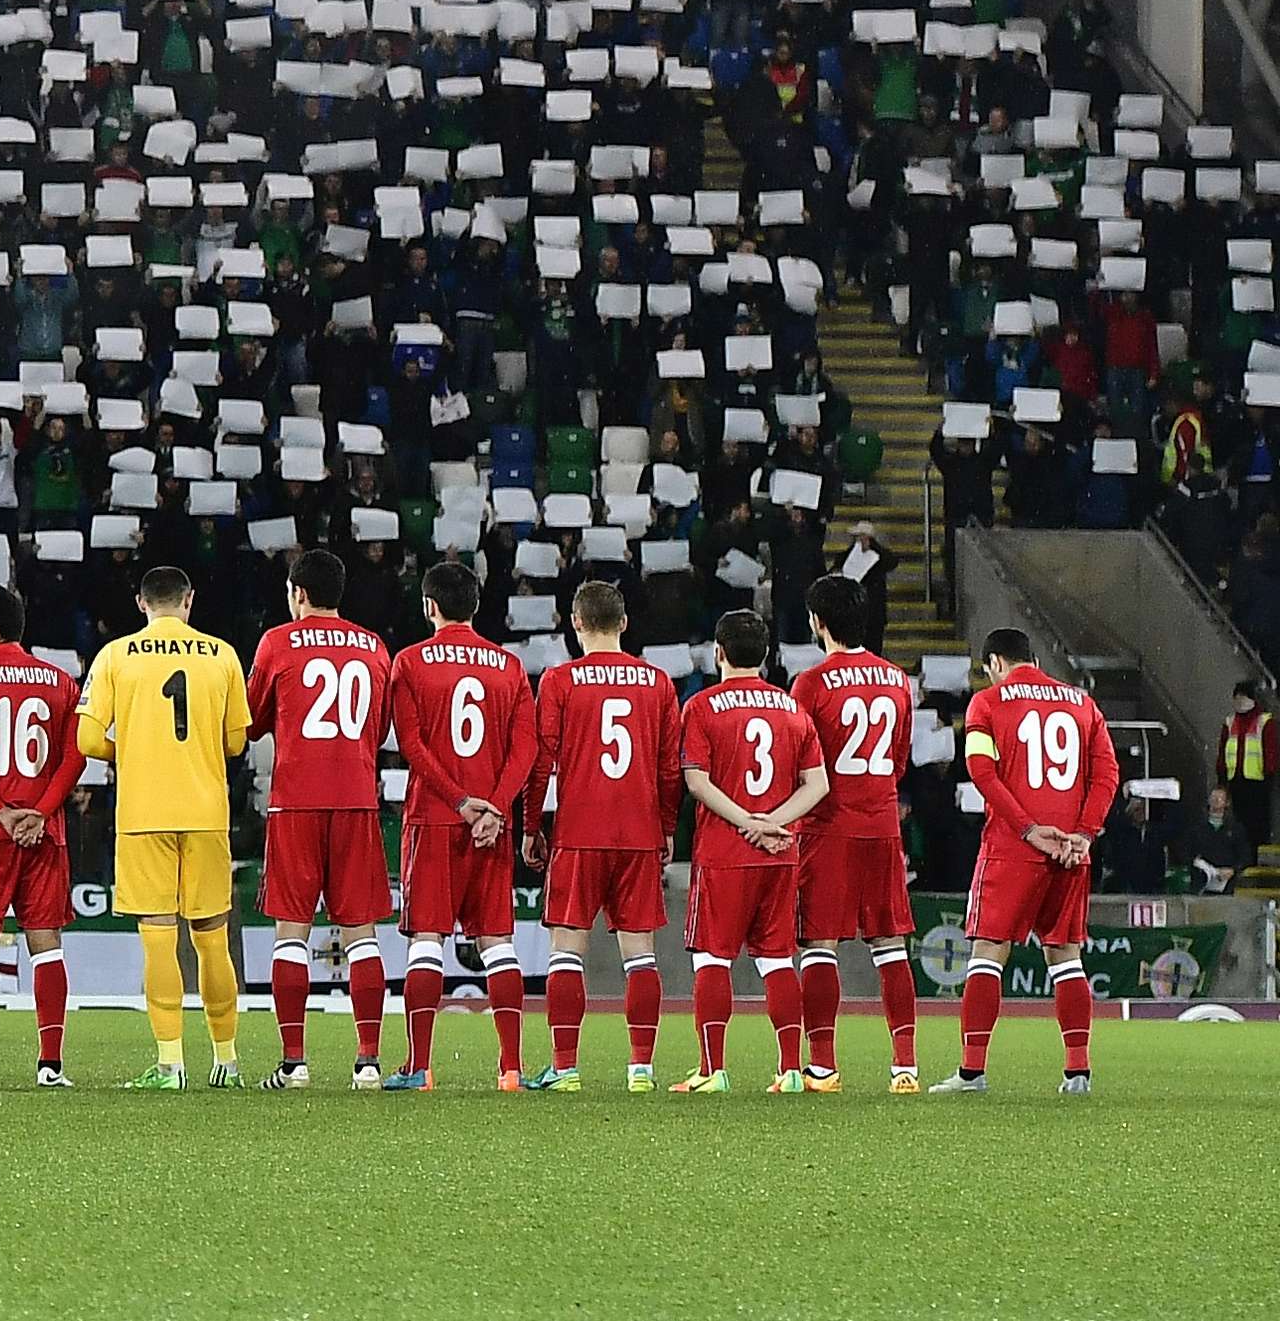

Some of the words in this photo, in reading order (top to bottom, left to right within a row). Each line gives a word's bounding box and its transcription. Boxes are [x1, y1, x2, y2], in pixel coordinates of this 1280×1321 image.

[127, 637, 221, 657] AGHAYEV
[289, 628, 377, 653] SHEIDAEV
[421, 645, 507, 672] GUSEYNOV
[571, 664, 657, 687] MEDVEDEV
[821, 666, 904, 690] ISMAYILOV
[162, 669, 188, 742] 1
[301, 658, 372, 740] 20
[450, 676, 485, 757] 6
[834, 696, 897, 776] 22
[600, 698, 632, 779] 5
[745, 717, 774, 796] 3
[1017, 710, 1080, 791] 19
